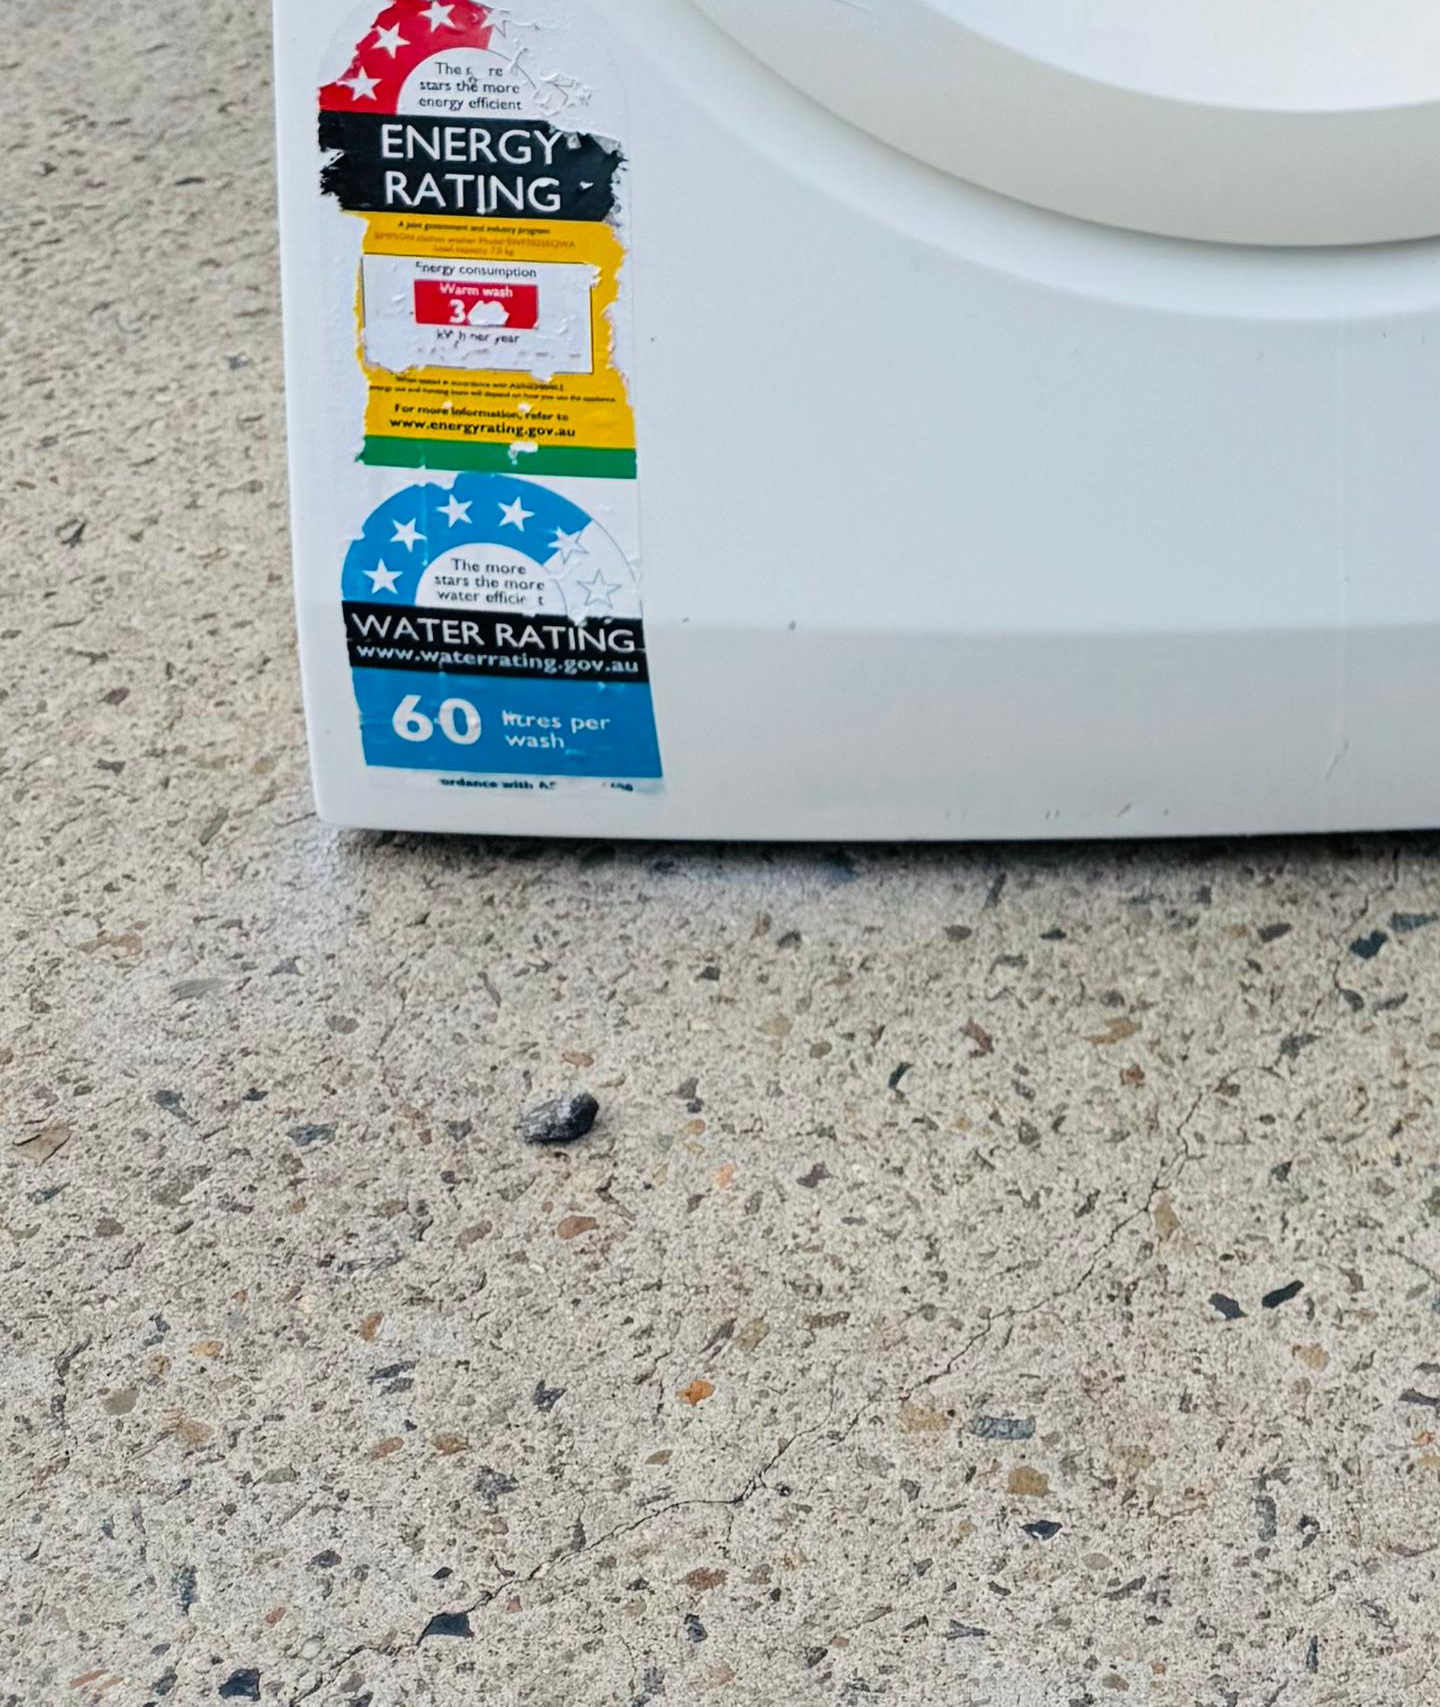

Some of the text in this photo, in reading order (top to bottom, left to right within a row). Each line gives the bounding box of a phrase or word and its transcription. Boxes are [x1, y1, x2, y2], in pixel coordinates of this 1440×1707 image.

[435, 61, 462, 75] The
[419, 80, 452, 91] stars
[483, 82, 520, 94] more
[419, 96, 523, 112] energy efficient
[381, 123, 565, 166] ENERGY
[384, 170, 561, 214] RATING
[458, 264, 537, 279] consumption
[439, 282, 513, 298] Warm wash
[389, 418, 576, 438] www.energyrating.gov.au
[450, 557, 527, 576] The more
[434, 575, 545, 591] stars the more
[437, 590, 480, 603] water
[350, 612, 636, 654] WATER RATING
[355, 644, 640, 674] www.waterrating.gov.au
[392, 694, 482, 746] 60
[570, 715, 611, 734] per
[504, 733, 566, 749] wash
